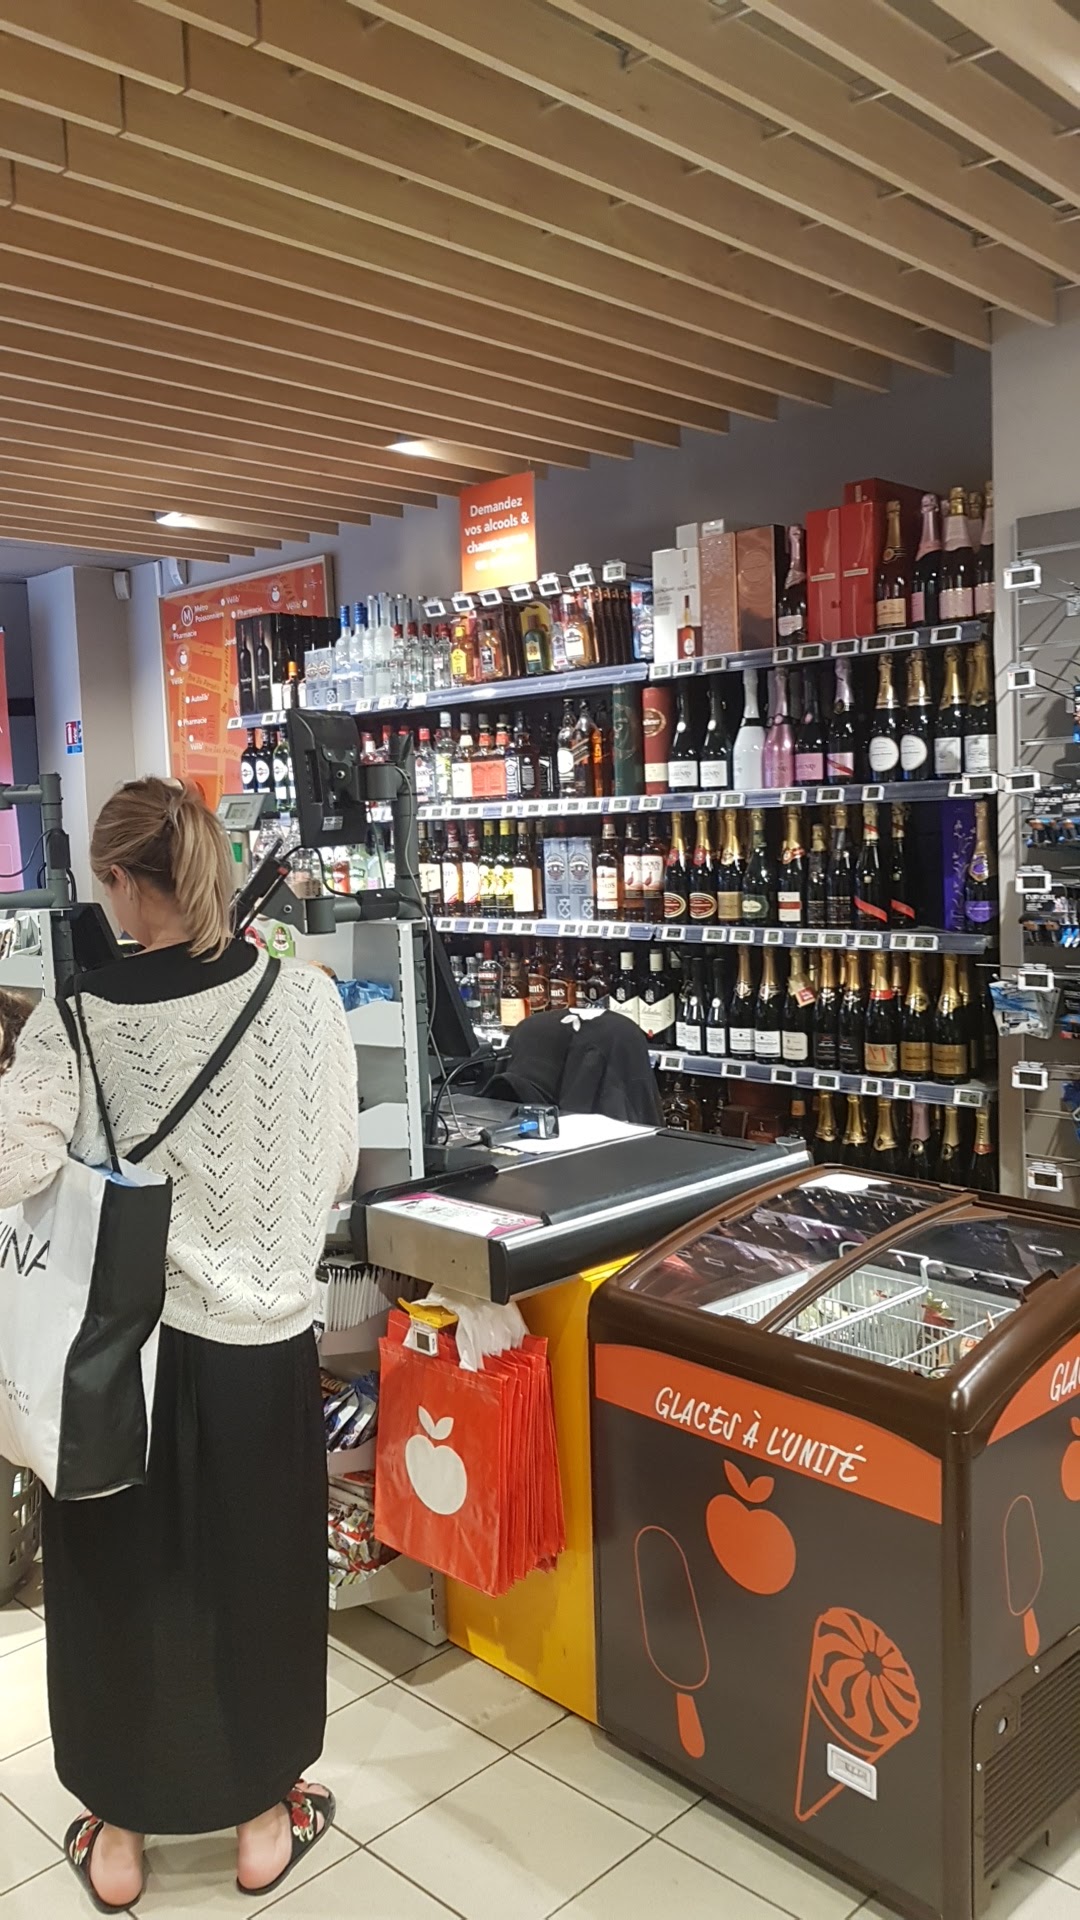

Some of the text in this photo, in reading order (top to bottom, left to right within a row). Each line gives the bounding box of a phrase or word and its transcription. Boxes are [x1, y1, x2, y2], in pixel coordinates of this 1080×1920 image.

[464, 511, 530, 536] vos alcools &
[470, 496, 523, 517] Demandez
[1050, 1356, 1080, 1401] GLA
[655, 1387, 867, 1483] GLACES À L'UNITÉ
